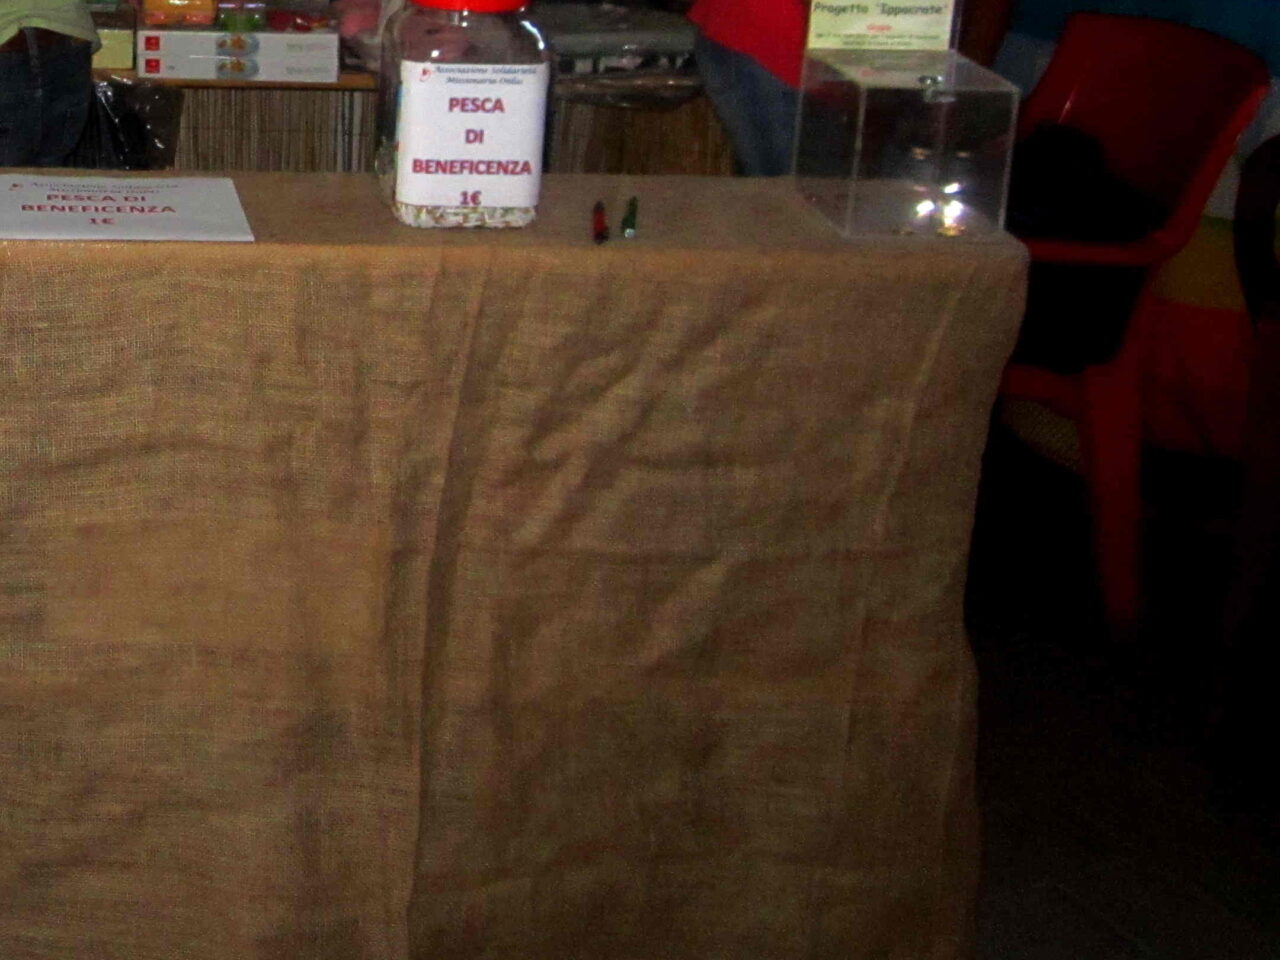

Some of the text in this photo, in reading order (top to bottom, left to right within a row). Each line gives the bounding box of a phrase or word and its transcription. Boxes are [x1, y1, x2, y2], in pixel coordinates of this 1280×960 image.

[814, 1, 869, 16] Progetto
[448, 97, 505, 113] PESCA
[464, 129, 485, 144] DI
[412, 159, 532, 176] BENEFICENZA
[46, 194, 116, 202] PESCA
[459, 190, 482, 206] 1€
[21, 204, 177, 214] BENEFICENZA
